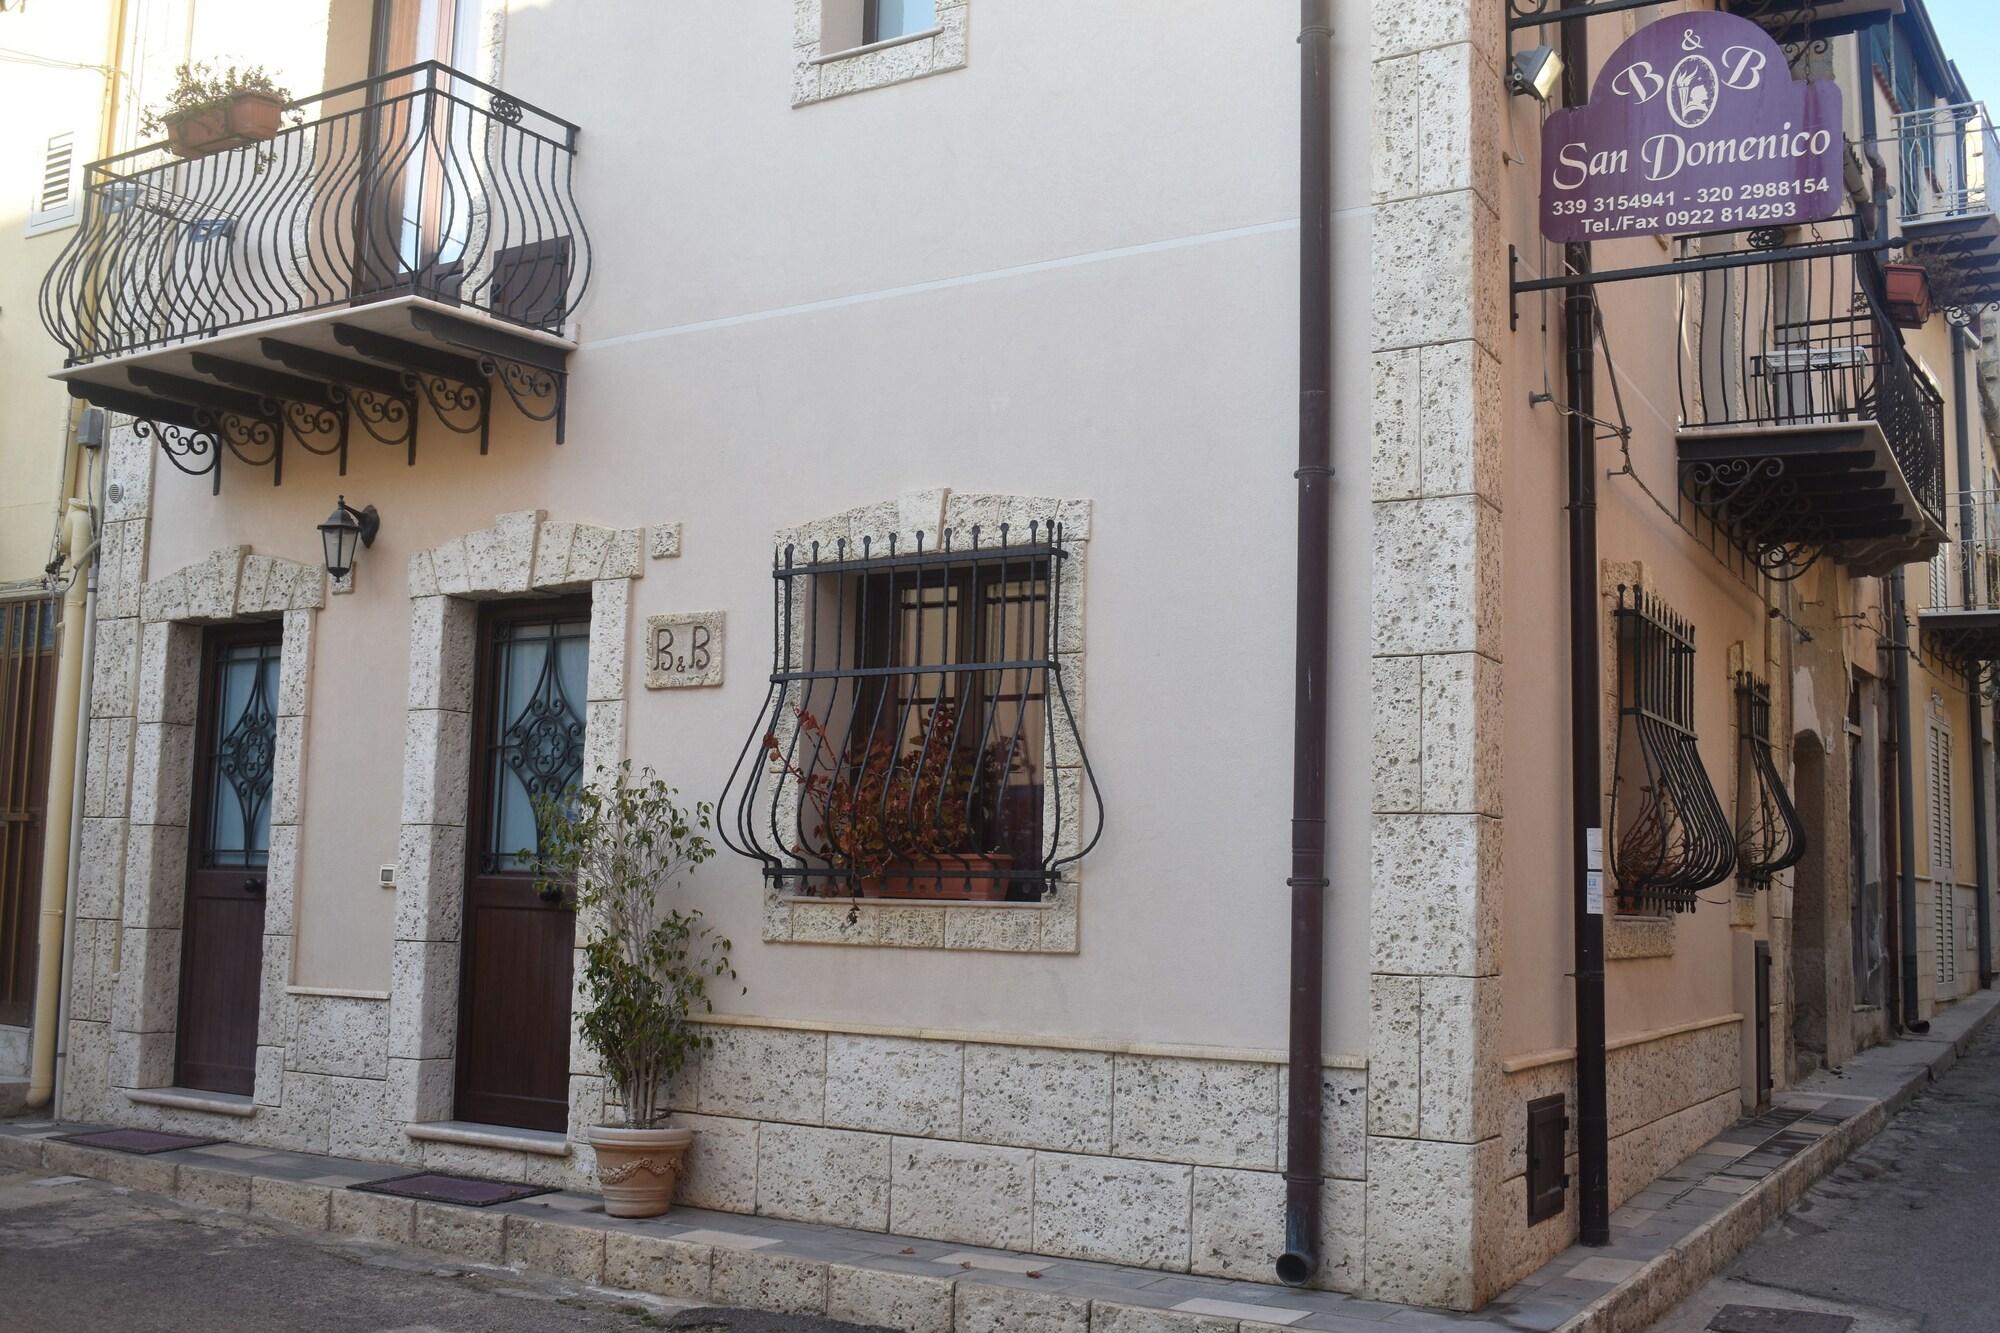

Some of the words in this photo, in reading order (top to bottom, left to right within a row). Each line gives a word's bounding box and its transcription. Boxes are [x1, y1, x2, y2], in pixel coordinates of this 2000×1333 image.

[1612, 61, 1664, 104] B
[1682, 29, 1704, 50] &
[1721, 45, 1766, 90] B
[1553, 142, 1629, 190] San
[1641, 122, 1831, 181] Domenico
[1552, 199, 1587, 216] 339
[1593, 191, 1675, 212] 3154941
[1697, 186, 1733, 203] 320
[1740, 177, 1829, 200] 2988154
[1581, 215, 1659, 234] Tel./Fax
[1665, 208, 1714, 227] 0922
[1721, 202, 1796, 222] 814293
